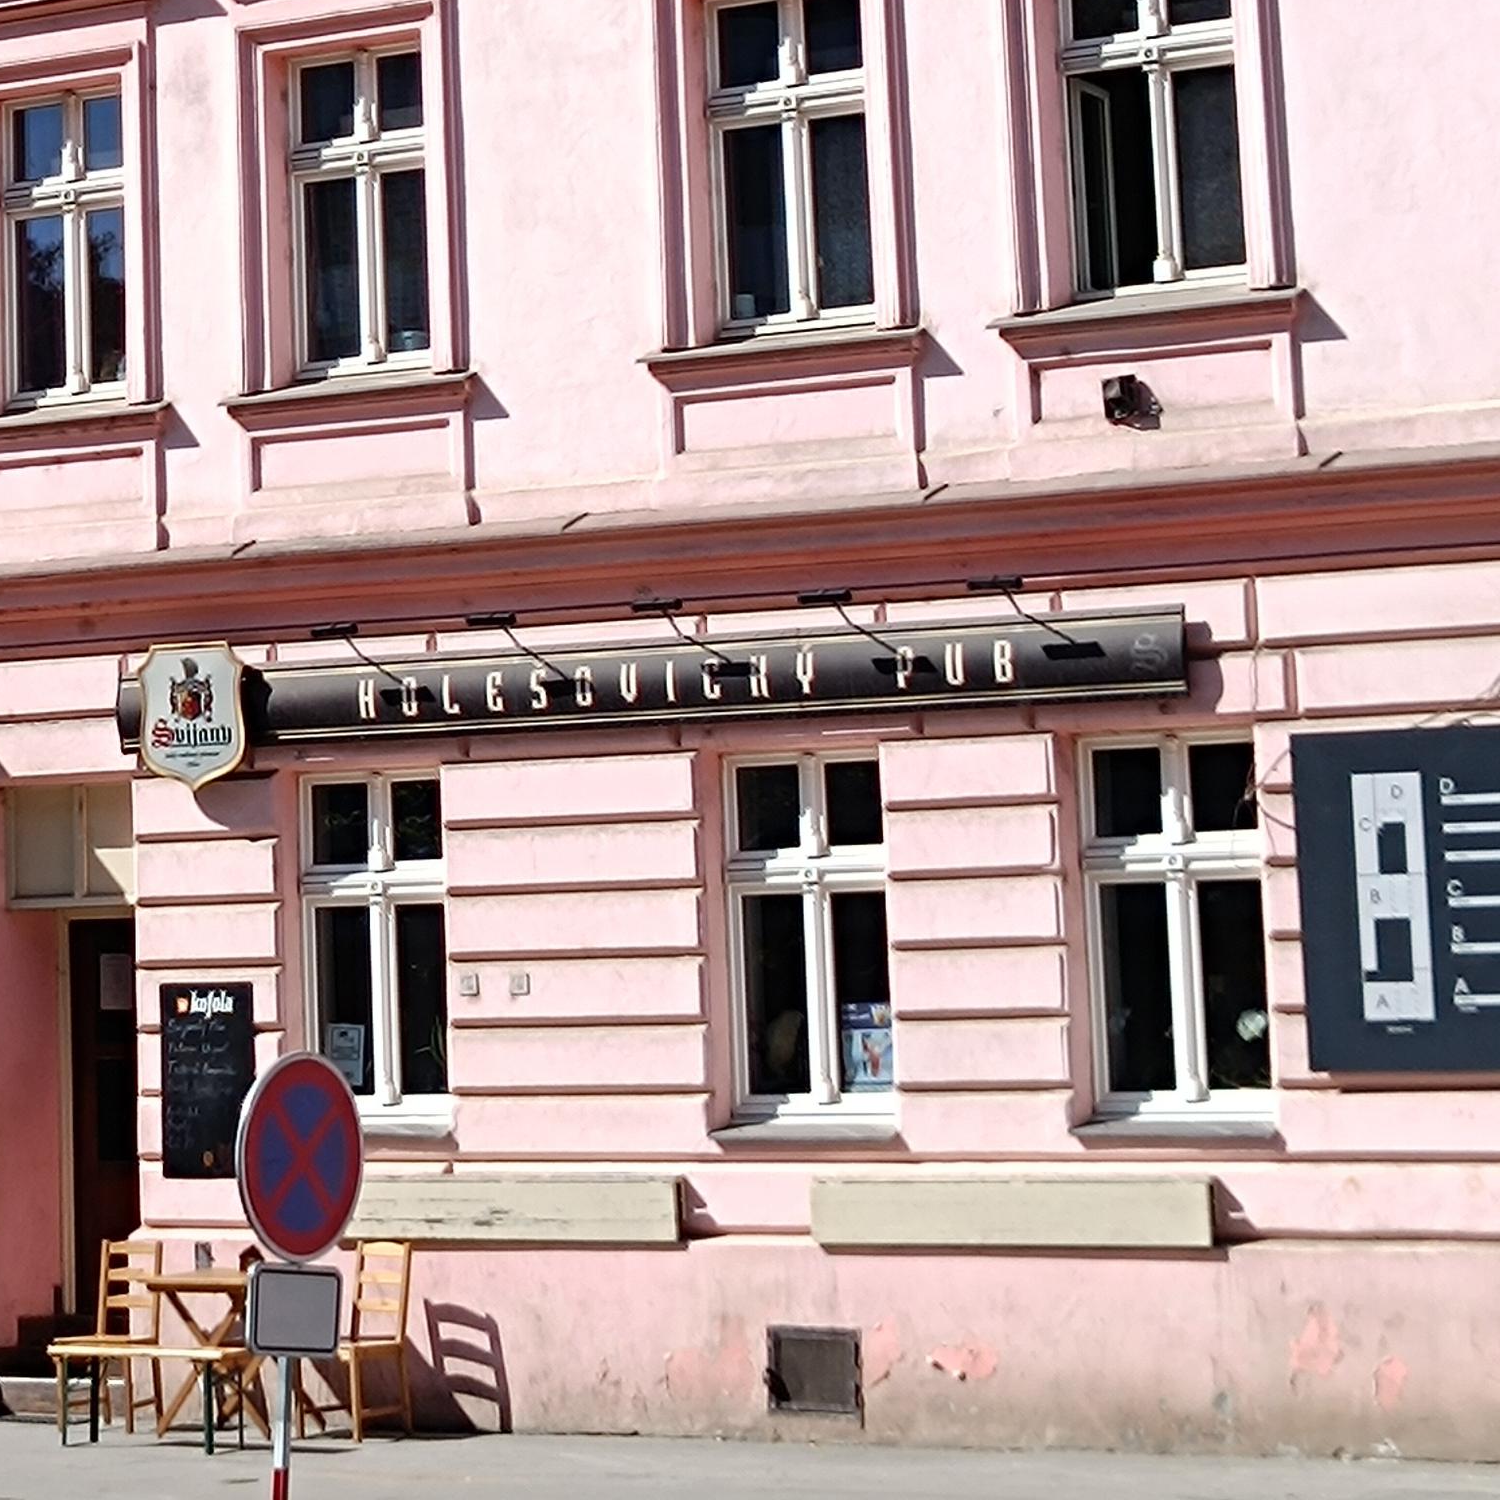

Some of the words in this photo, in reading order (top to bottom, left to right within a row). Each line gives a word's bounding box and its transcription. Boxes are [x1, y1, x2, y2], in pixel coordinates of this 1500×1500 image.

[895, 639, 1014, 690] PUB
[151, 718, 232, 748] Svijany
[1440, 777, 1455, 794] D
[1451, 924, 1466, 942] B
[1454, 977, 1471, 995] A
